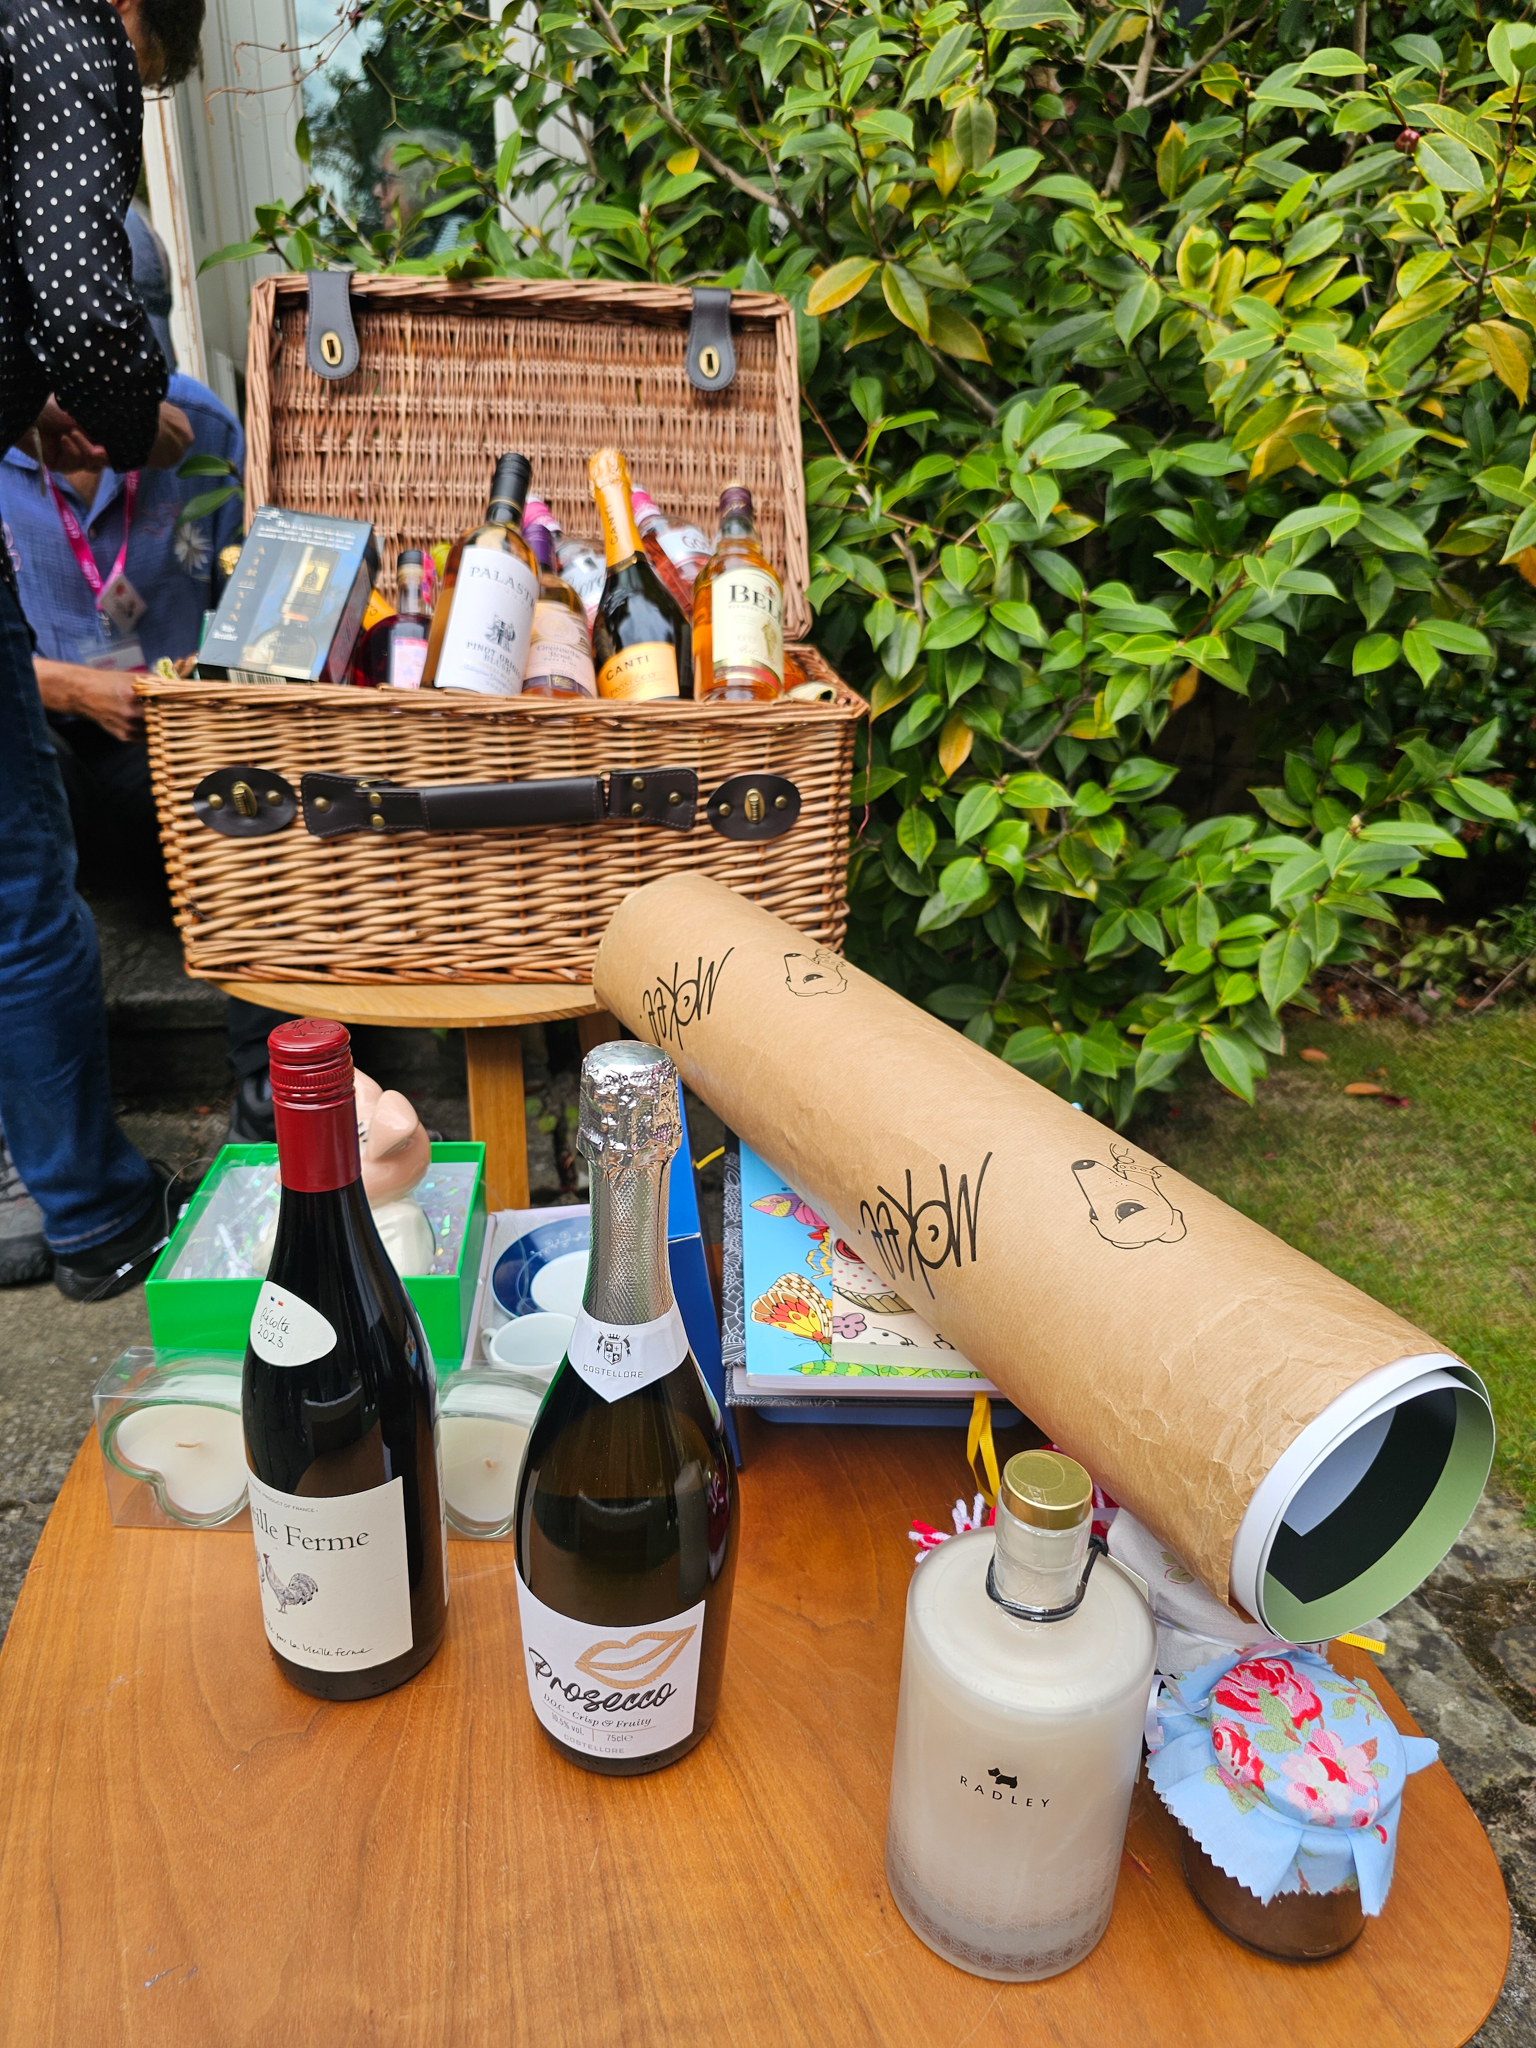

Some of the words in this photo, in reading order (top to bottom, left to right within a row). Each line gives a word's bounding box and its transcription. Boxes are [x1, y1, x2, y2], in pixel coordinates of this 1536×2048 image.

[604, 504, 619, 546] CANTI
[466, 641, 496, 657] PINOT
[606, 655, 649, 681] CANTI
[258, 1324, 284, 1349] 2023
[583, 1364, 644, 1378] COSTELLORE
[284, 1524, 370, 1551] Ferme
[528, 1646, 678, 1713] Prosecco
[572, 1711, 599, 1727] Crisp
[601, 1719, 614, 1727] &
[615, 1718, 652, 1728] Fruity
[563, 1733, 625, 1754] COSTELLORE
[960, 1775, 1050, 1808] RADLEY
